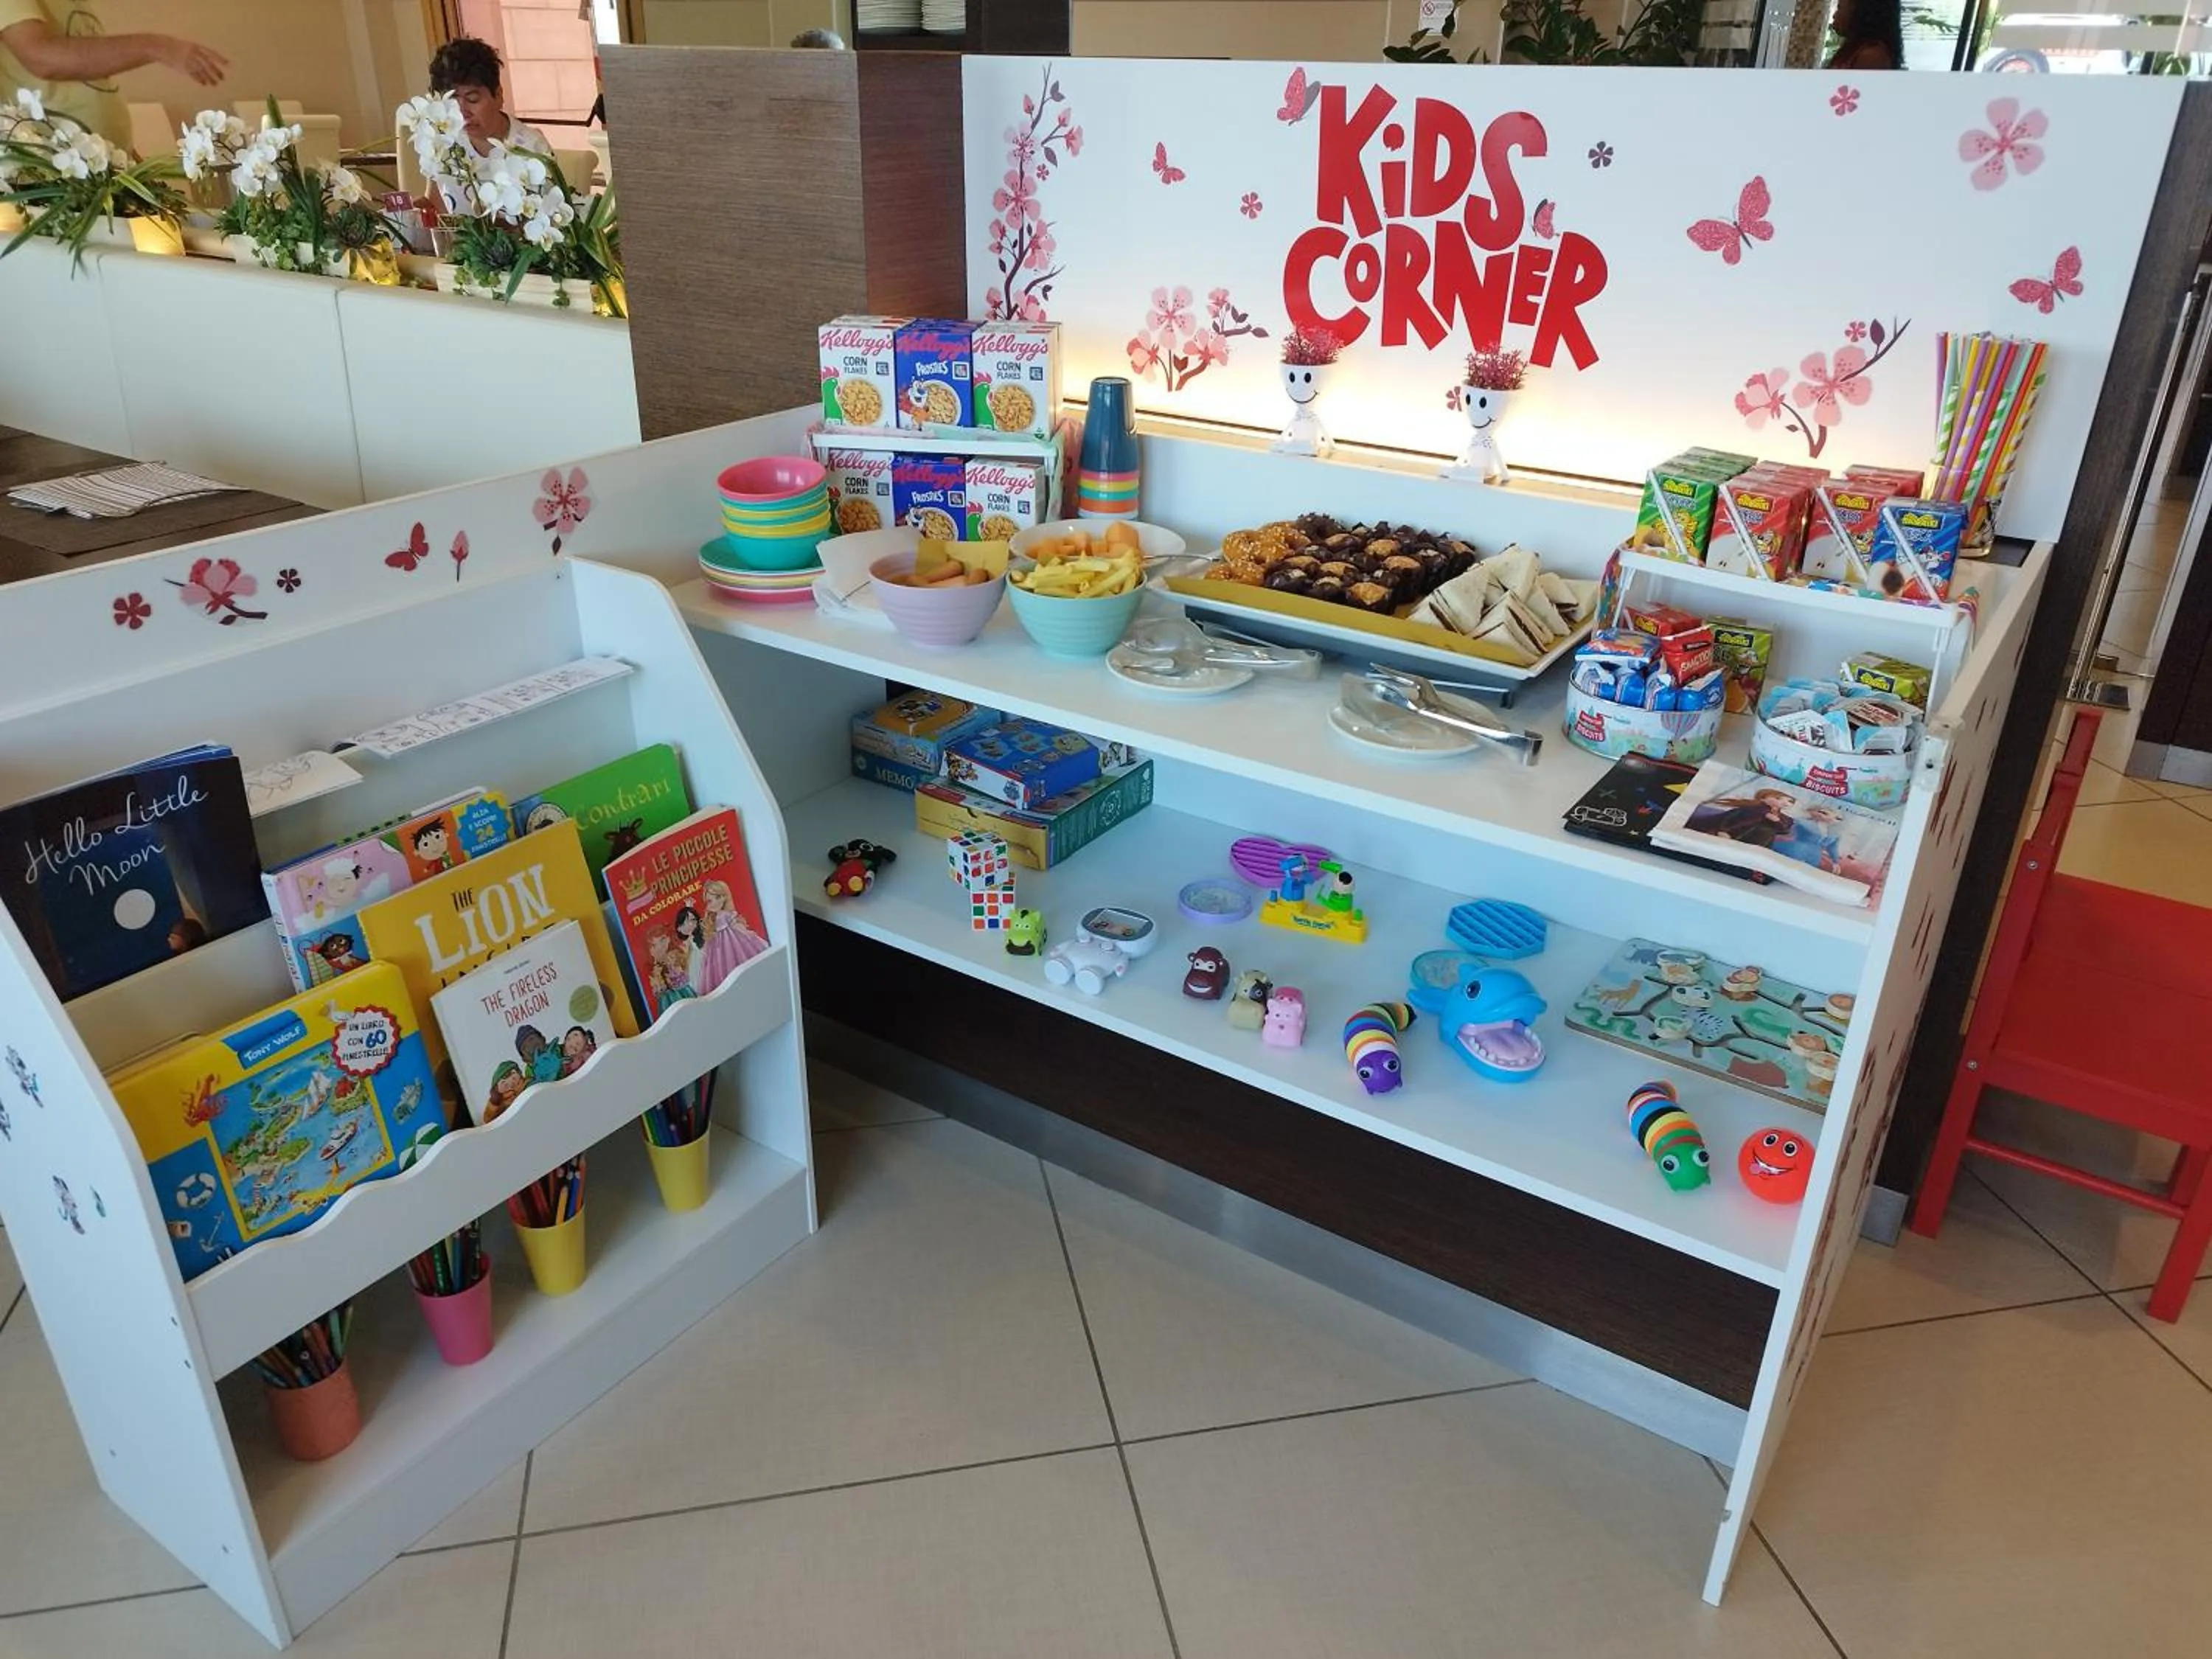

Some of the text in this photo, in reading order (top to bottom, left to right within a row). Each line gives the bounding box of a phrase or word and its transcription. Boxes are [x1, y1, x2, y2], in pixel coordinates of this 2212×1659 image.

[1283, 221, 1608, 371] CORNER
[821, 330, 893, 355] Kellogg's
[897, 333, 970, 359] Kellogg's
[973, 333, 1048, 361] Kellogg's
[843, 356, 868, 366] CORN
[844, 366, 868, 375] FLAKES
[996, 361, 1021, 371] CORN
[996, 371, 1021, 380] FLAKES
[844, 477, 869, 487] CORN
[894, 464, 967, 488] Kellogg's
[966, 467, 1035, 494] Kellogg's
[845, 486, 869, 495] FLAKES
[987, 493, 1011, 504] CORN
[987, 503, 1011, 512] FLAKES
[876, 765, 914, 789] MEMO
[1806, 782, 1846, 796] BISCUITS
[574, 779, 671, 830] Contrari
[25, 775, 209, 884] Hello Little
[651, 824, 728, 873] LE PICCOLE
[69, 844, 166, 896] Moon
[651, 844, 733, 897] PRINCIPESSE
[451, 887, 476, 911] THE
[633, 880, 702, 926] DA COLORARE
[414, 863, 555, 973] LION
[480, 990, 506, 1015] THE
[509, 961, 557, 1001] FIRELESS
[504, 991, 550, 1027] DRAGON
[347, 1029, 386, 1048] CON 60
[349, 1023, 359, 1032] UN
